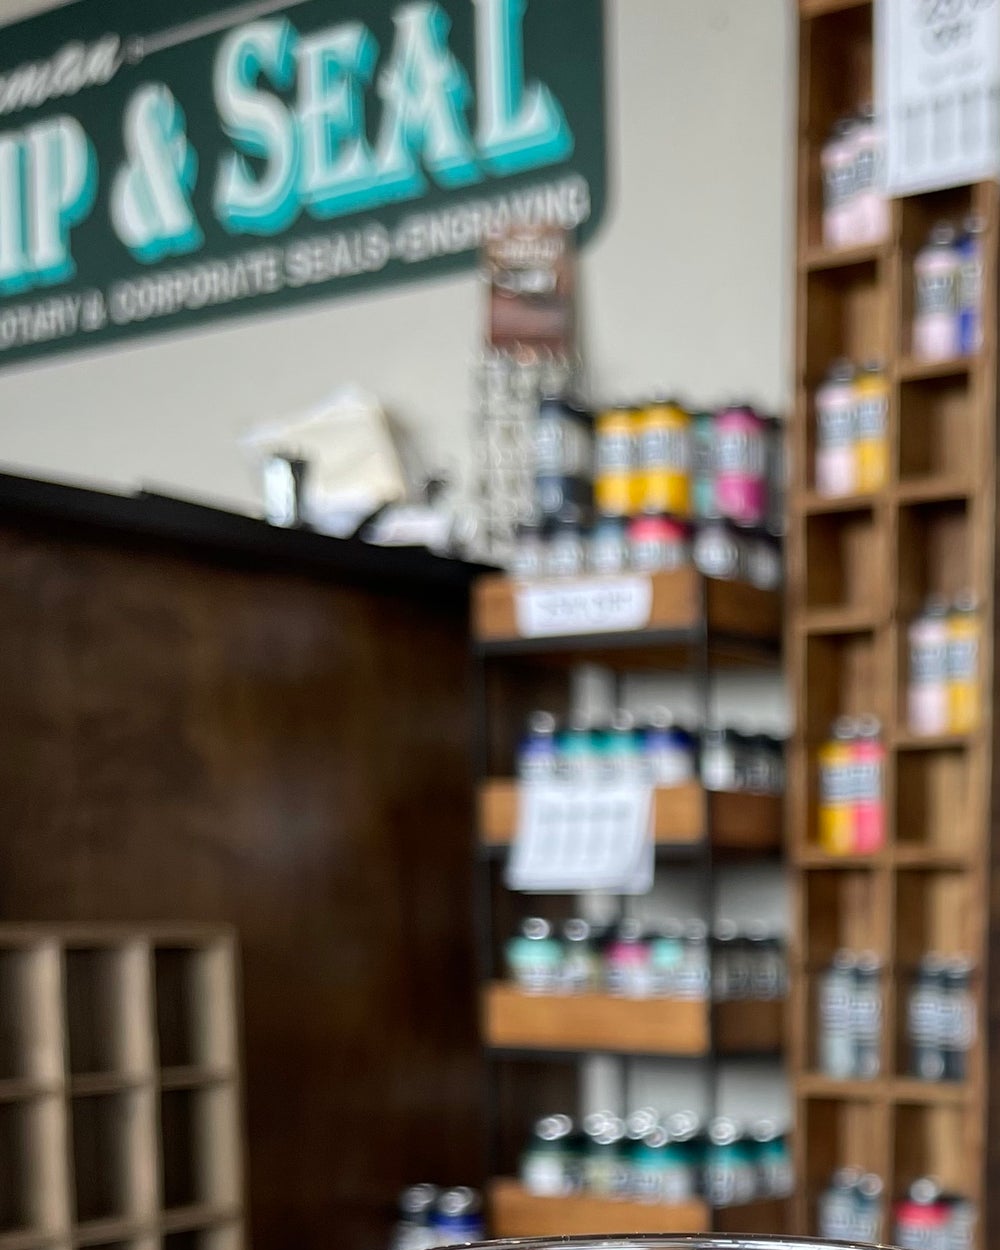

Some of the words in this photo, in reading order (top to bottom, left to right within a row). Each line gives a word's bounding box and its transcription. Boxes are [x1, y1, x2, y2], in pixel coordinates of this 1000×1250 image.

[110, 81, 204, 264] &
[213, 0, 576, 236] SEAL
[109, 247, 284, 326] CORPORATE
[285, 217, 389, 288] SEALS
